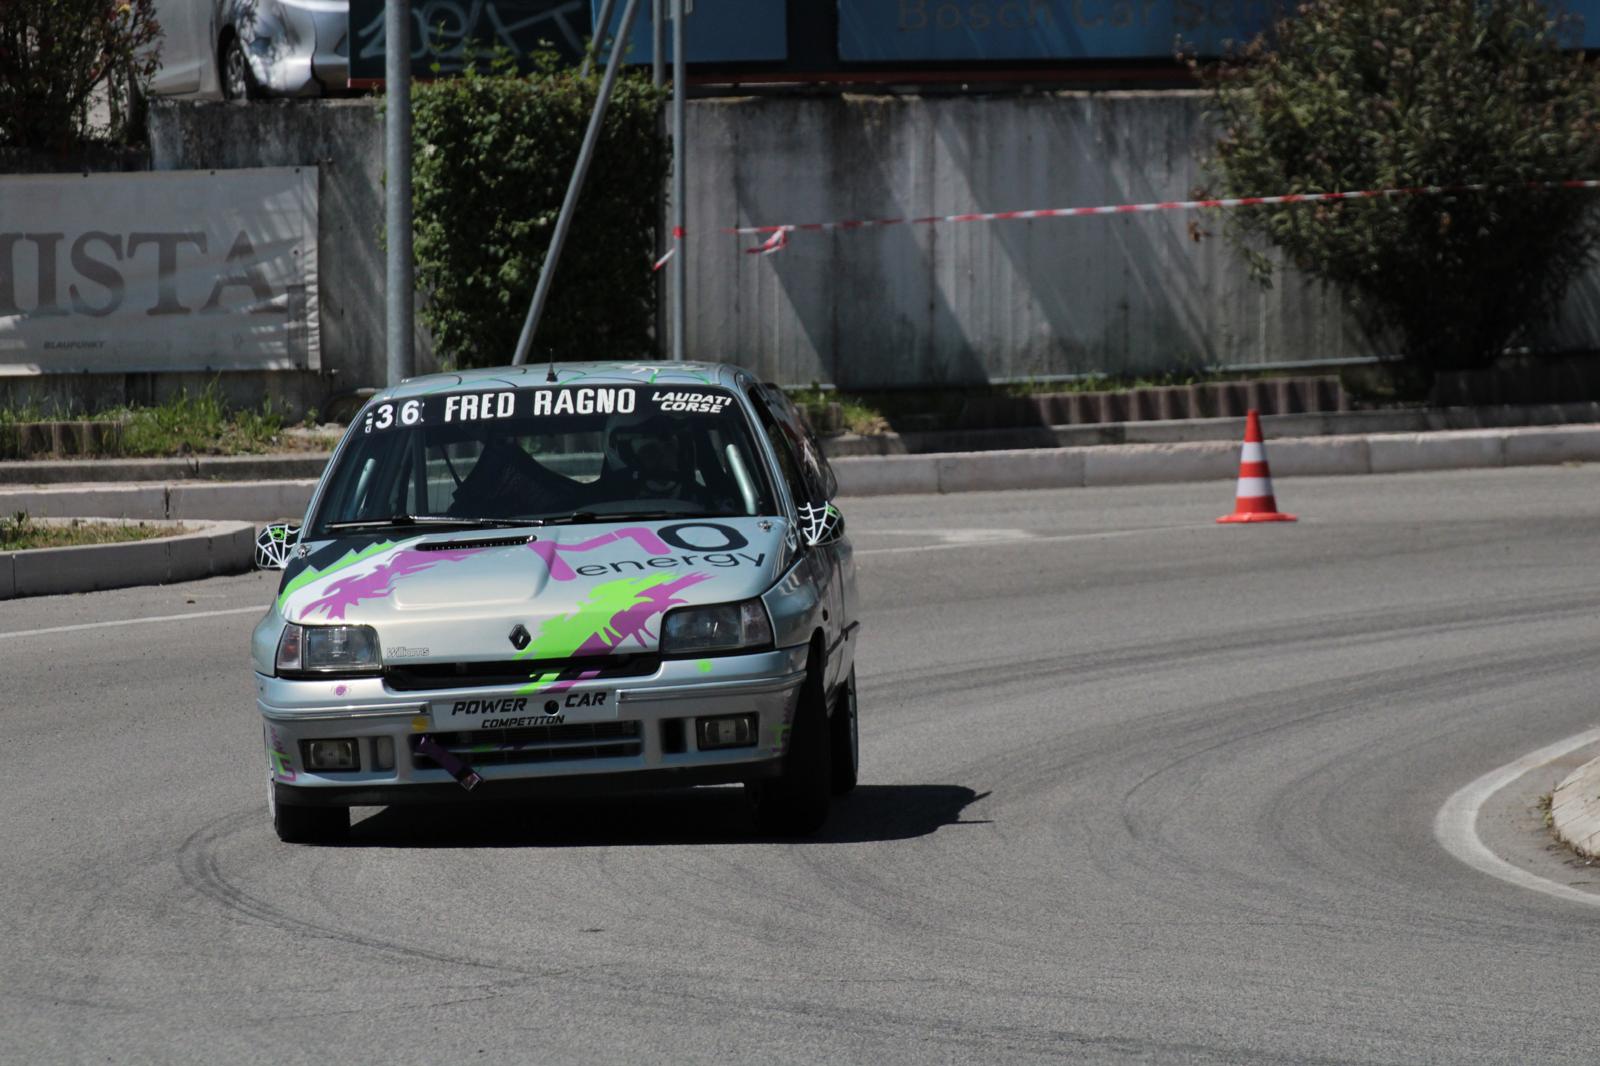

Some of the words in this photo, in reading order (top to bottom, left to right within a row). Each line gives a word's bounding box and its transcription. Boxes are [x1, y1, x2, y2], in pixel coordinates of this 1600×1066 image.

[443, 391, 515, 422] FRED
[533, 388, 636, 416] RAGNO
[652, 391, 733, 406] LAUDATI
[660, 401, 723, 414] CORSE
[375, 400, 420, 430] 36
[575, 552, 766, 578] energy
[386, 646, 430, 658] Williams
[452, 697, 529, 717] POWER
[564, 692, 607, 709] CAR
[481, 715, 566, 730] COMPETITON
